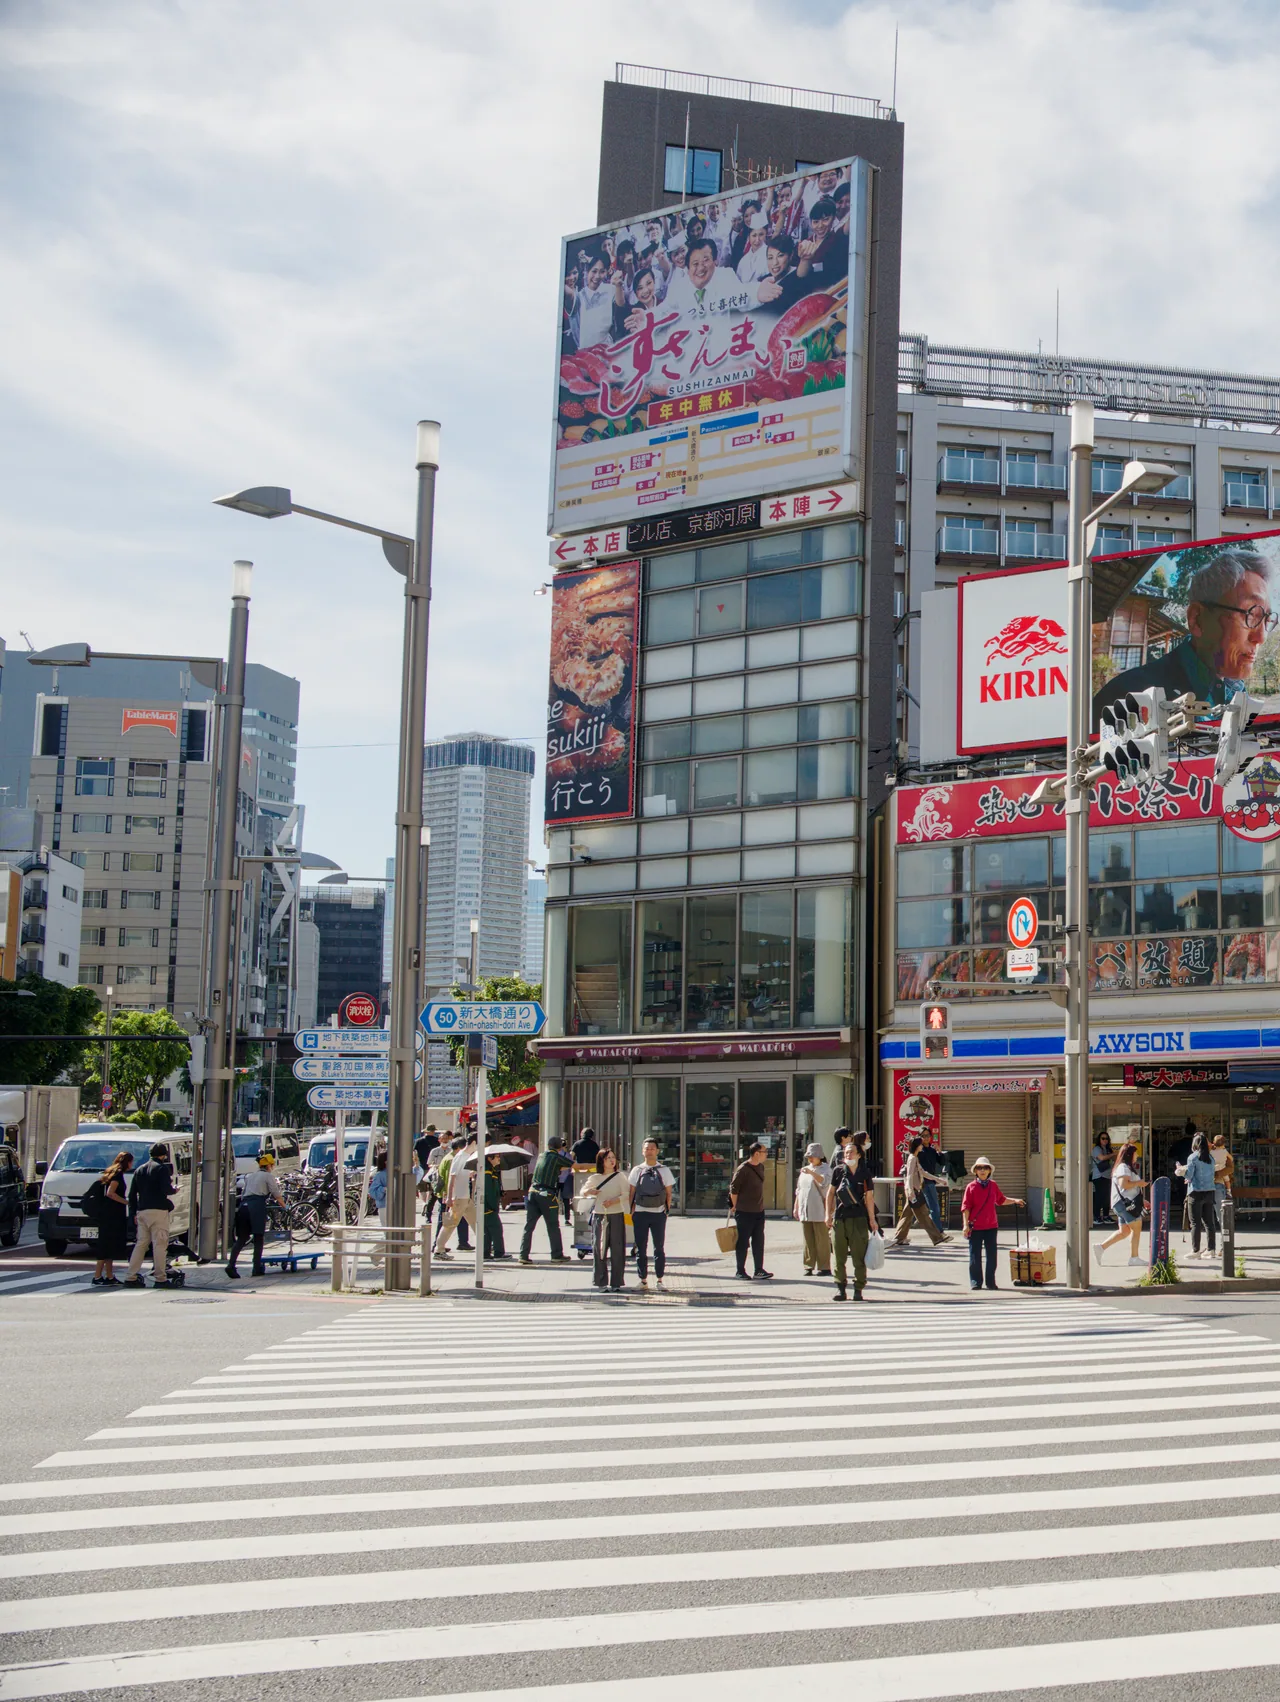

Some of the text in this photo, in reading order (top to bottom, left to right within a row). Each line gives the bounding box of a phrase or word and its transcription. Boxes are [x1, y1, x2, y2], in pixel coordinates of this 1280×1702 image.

[668, 369, 755, 395] SUSHIZANMAI
[1037, 368, 1219, 408] TOKYU STAY
[659, 389, 733, 420] 年中無休
[768, 496, 811, 522] 本陣
[583, 531, 621, 557] 本店
[980, 664, 1069, 703] KIRIN
[126, 710, 177, 721] TableMark
[551, 776, 612, 812] 行こう
[349, 1006, 373, 1016] 消火栓
[440, 1006, 531, 1024] 50 新大橋通り
[458, 1020, 516, 1029] Shin-ohashi-dori
[322, 1033, 390, 1042] 地下鉄築地市場
[322, 1062, 390, 1071] 聖路加国際病
[335, 1090, 382, 1099] 築地本願寺
